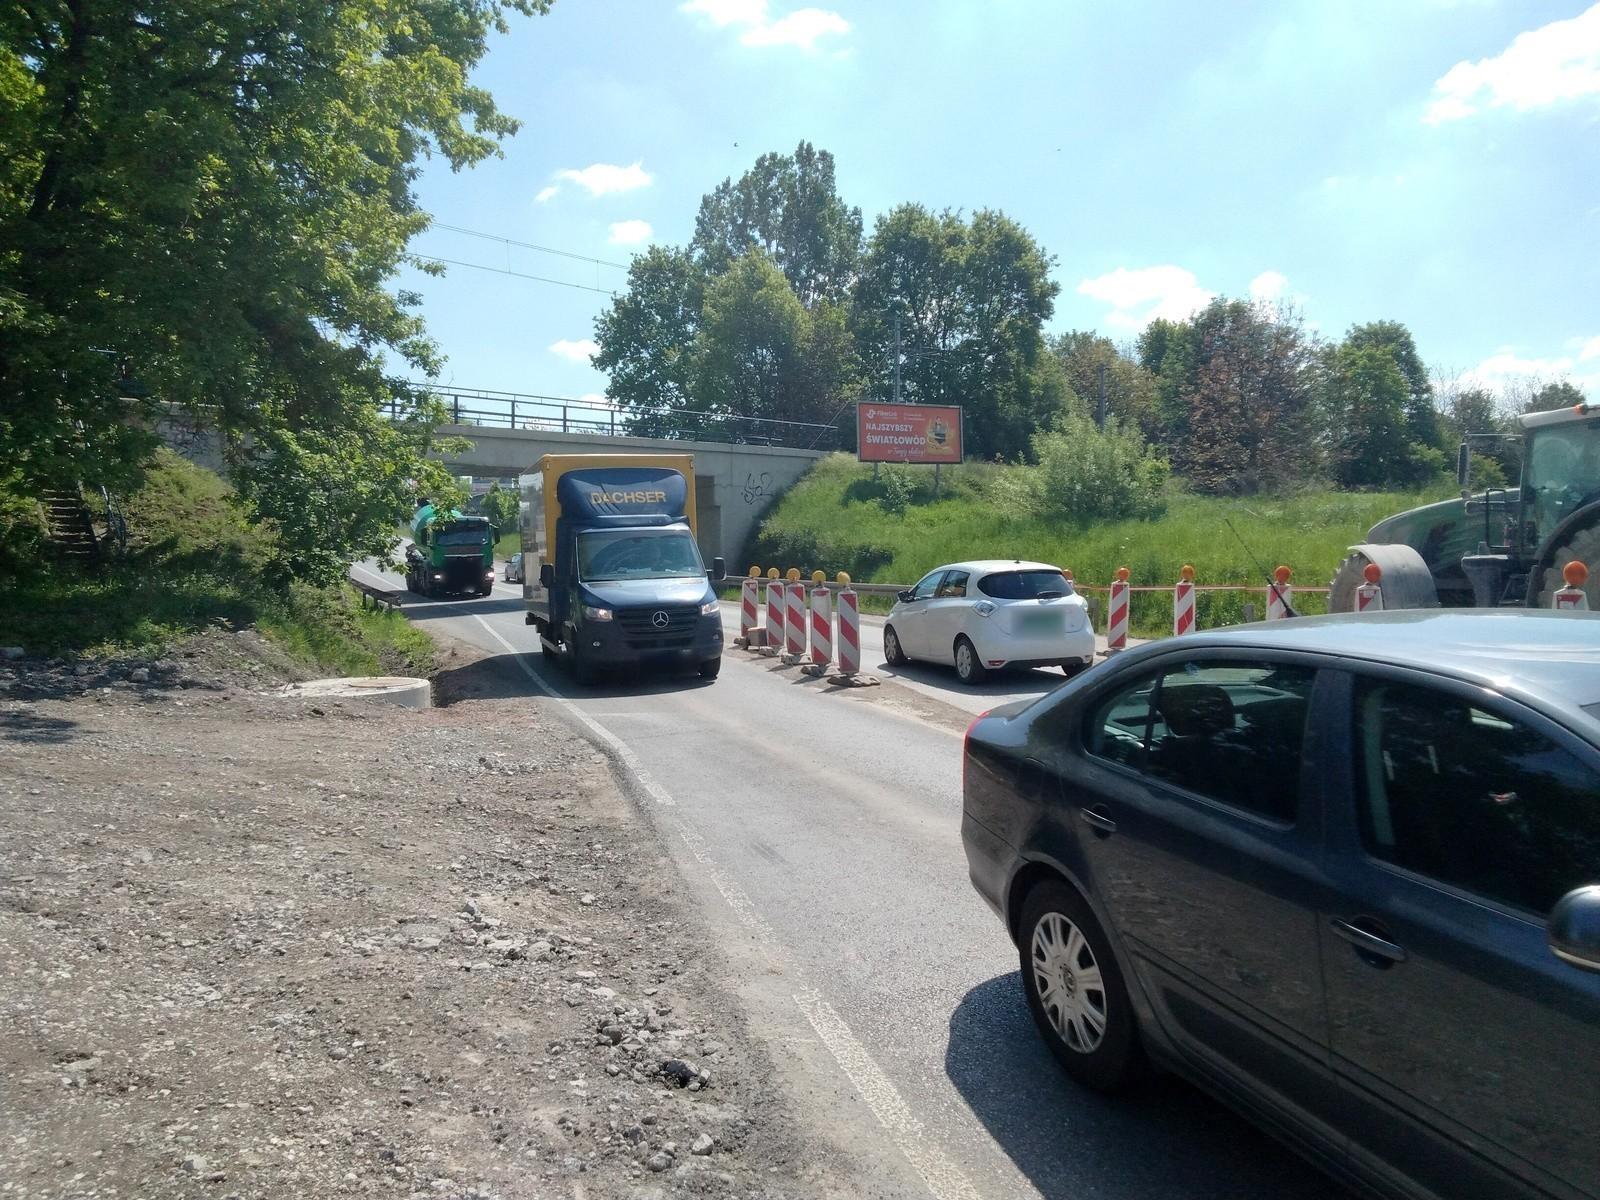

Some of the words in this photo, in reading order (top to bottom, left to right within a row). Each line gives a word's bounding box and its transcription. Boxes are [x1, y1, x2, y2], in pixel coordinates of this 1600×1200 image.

[866, 423, 913, 432] NAJSZYBSZY
[866, 433, 926, 445] ŚWIATŁOWÓD
[591, 491, 667, 504] DACHSER
